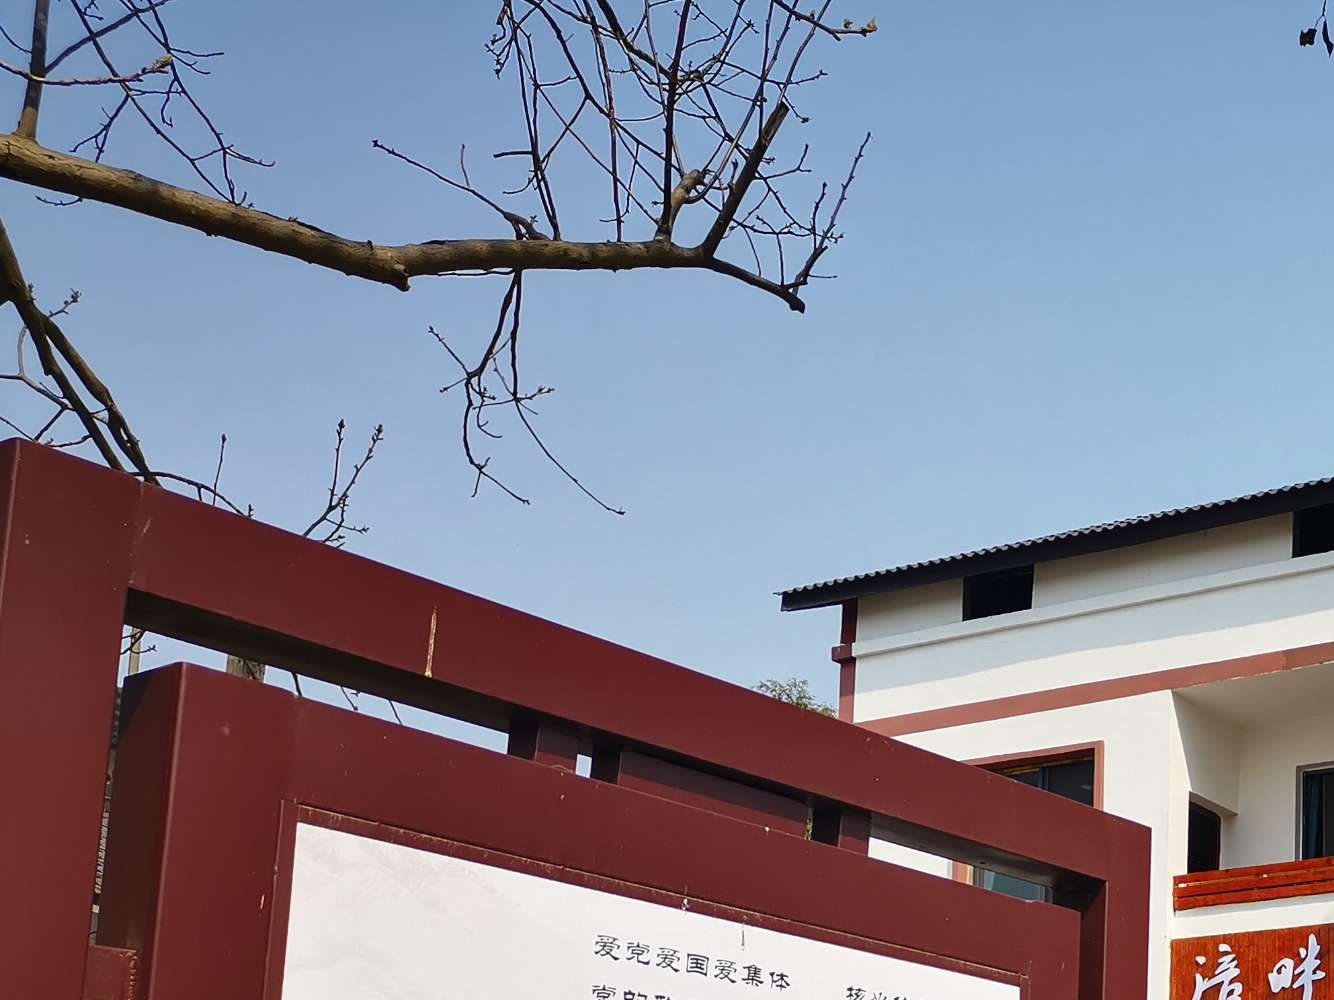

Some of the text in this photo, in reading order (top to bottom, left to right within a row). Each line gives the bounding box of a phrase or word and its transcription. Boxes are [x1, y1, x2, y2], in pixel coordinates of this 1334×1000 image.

[594, 935, 790, 990] 爱党爱国爱集体
